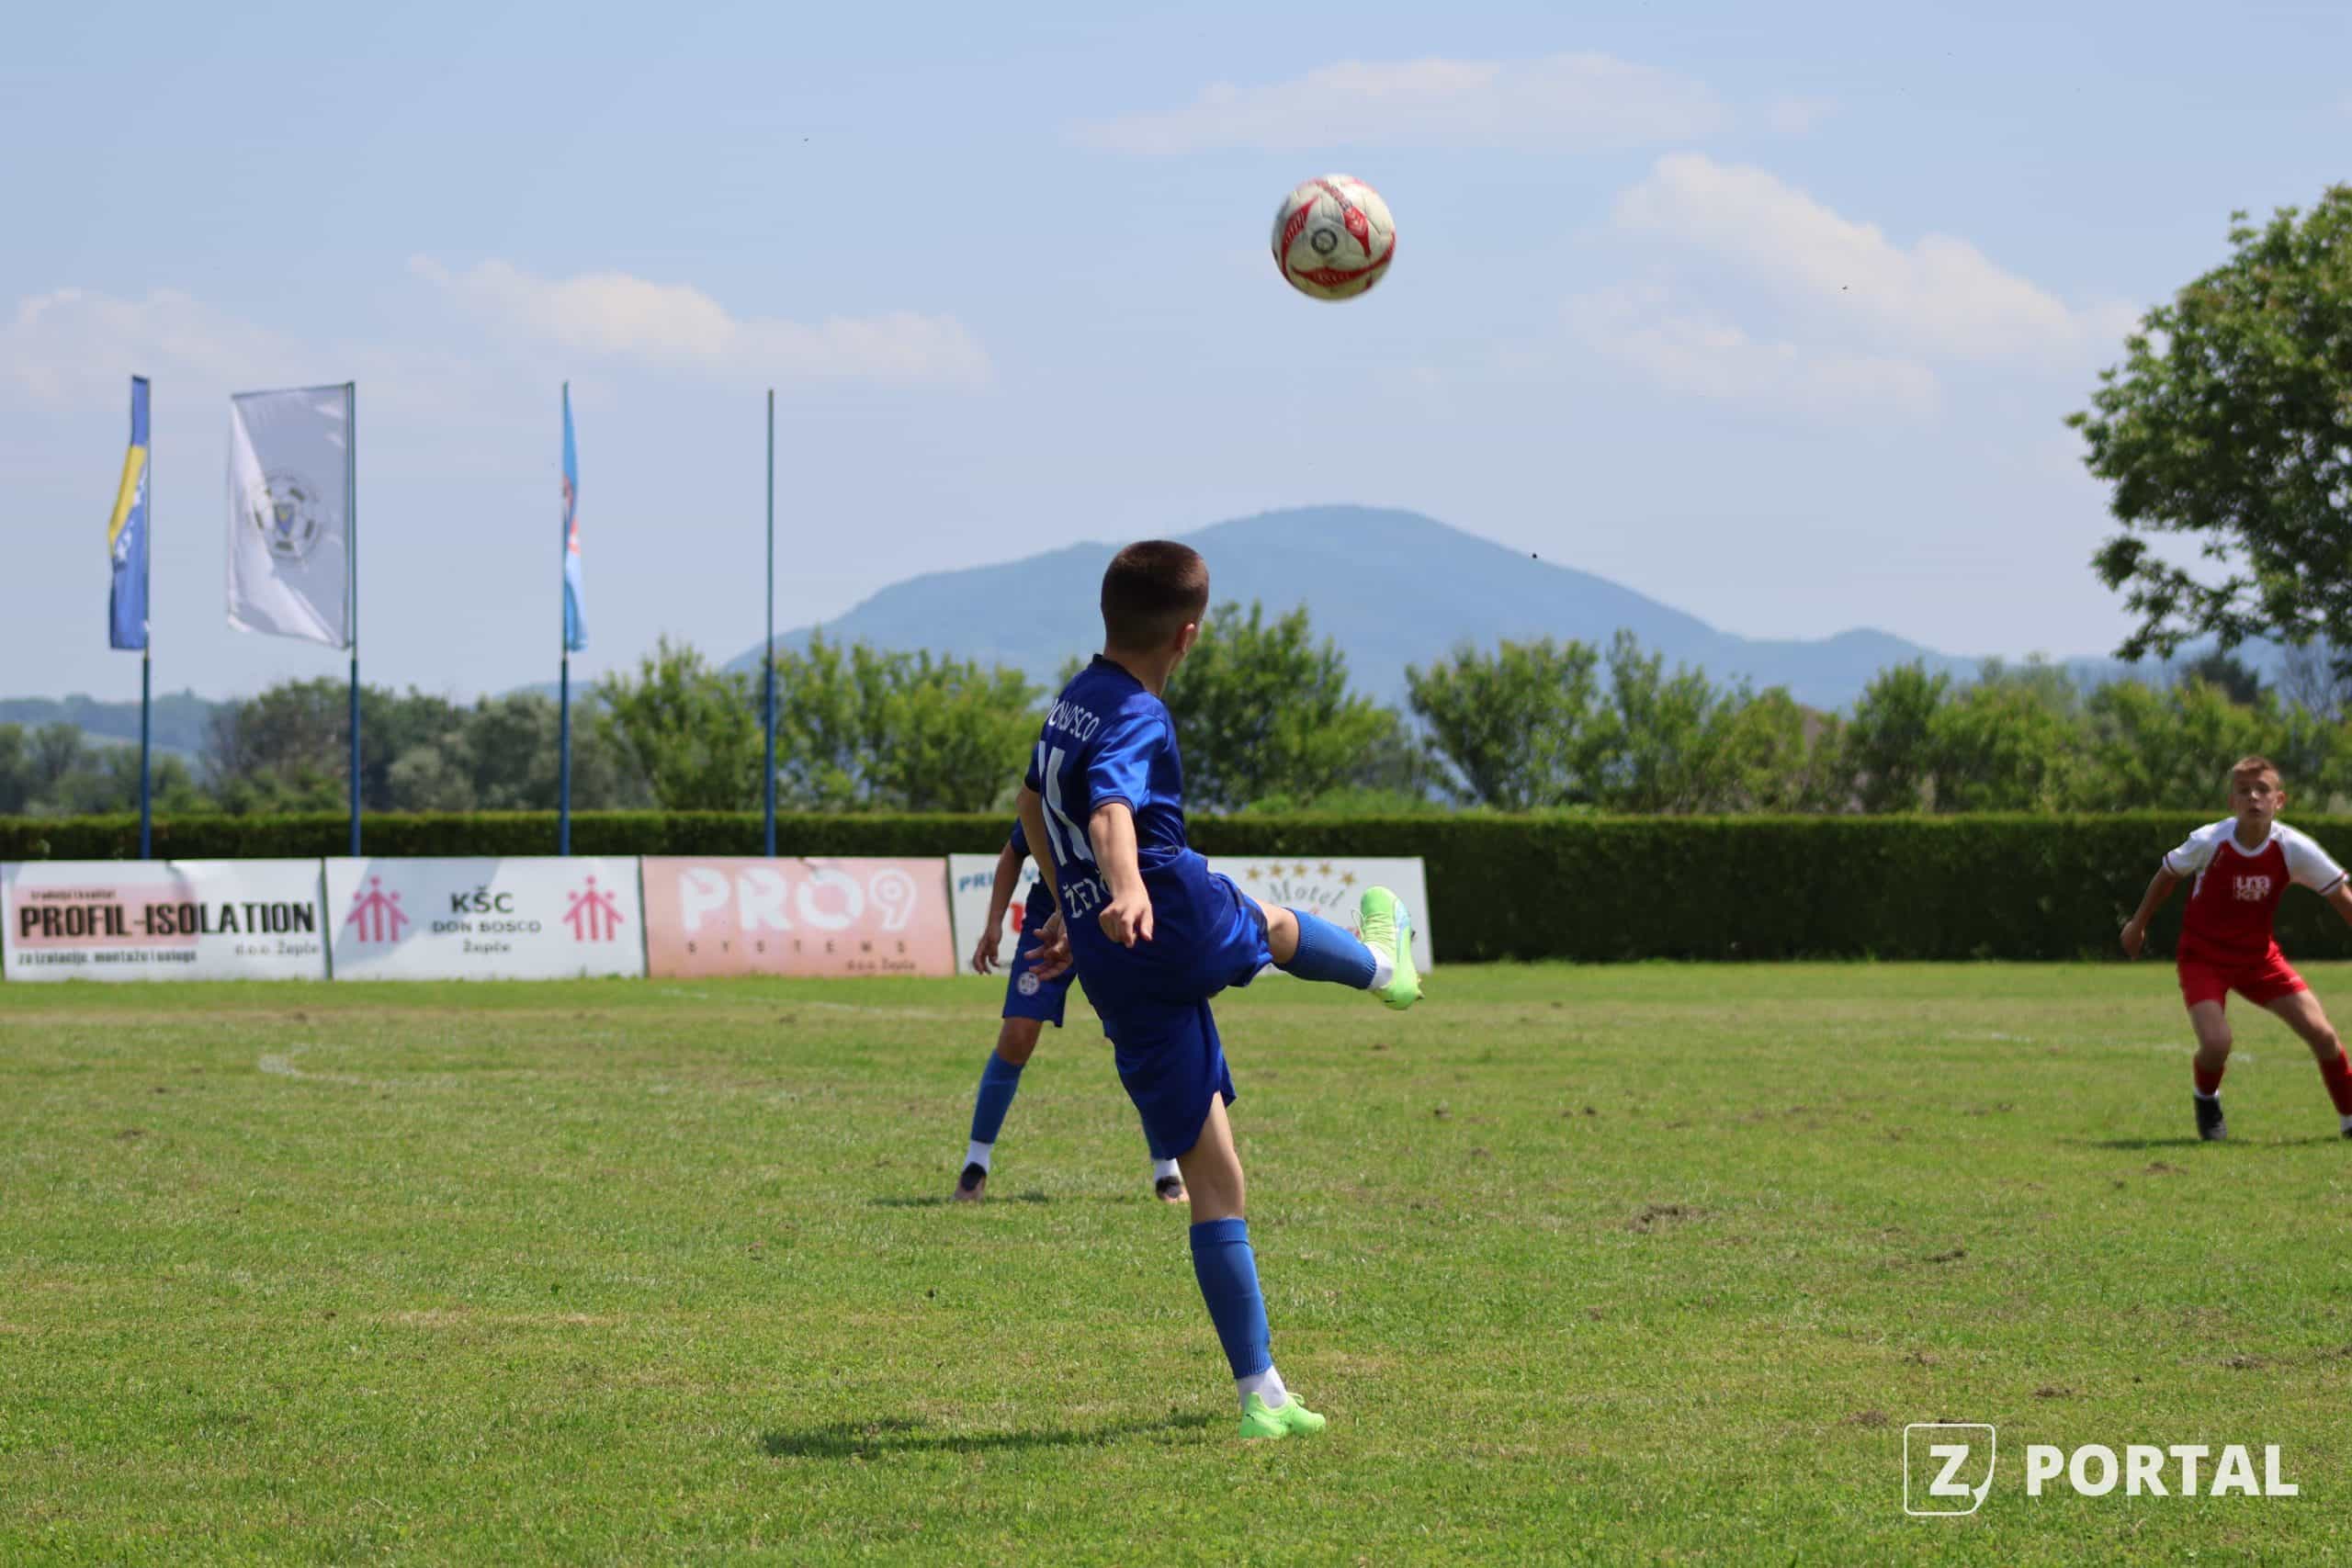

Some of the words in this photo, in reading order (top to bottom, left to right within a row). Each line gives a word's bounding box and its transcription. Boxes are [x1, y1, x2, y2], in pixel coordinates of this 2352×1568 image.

[450, 884, 514, 914] KŠC
[1267, 878, 1345, 908] Motel
[431, 920, 472, 934] DON
[479, 919, 542, 933] BOSCO
